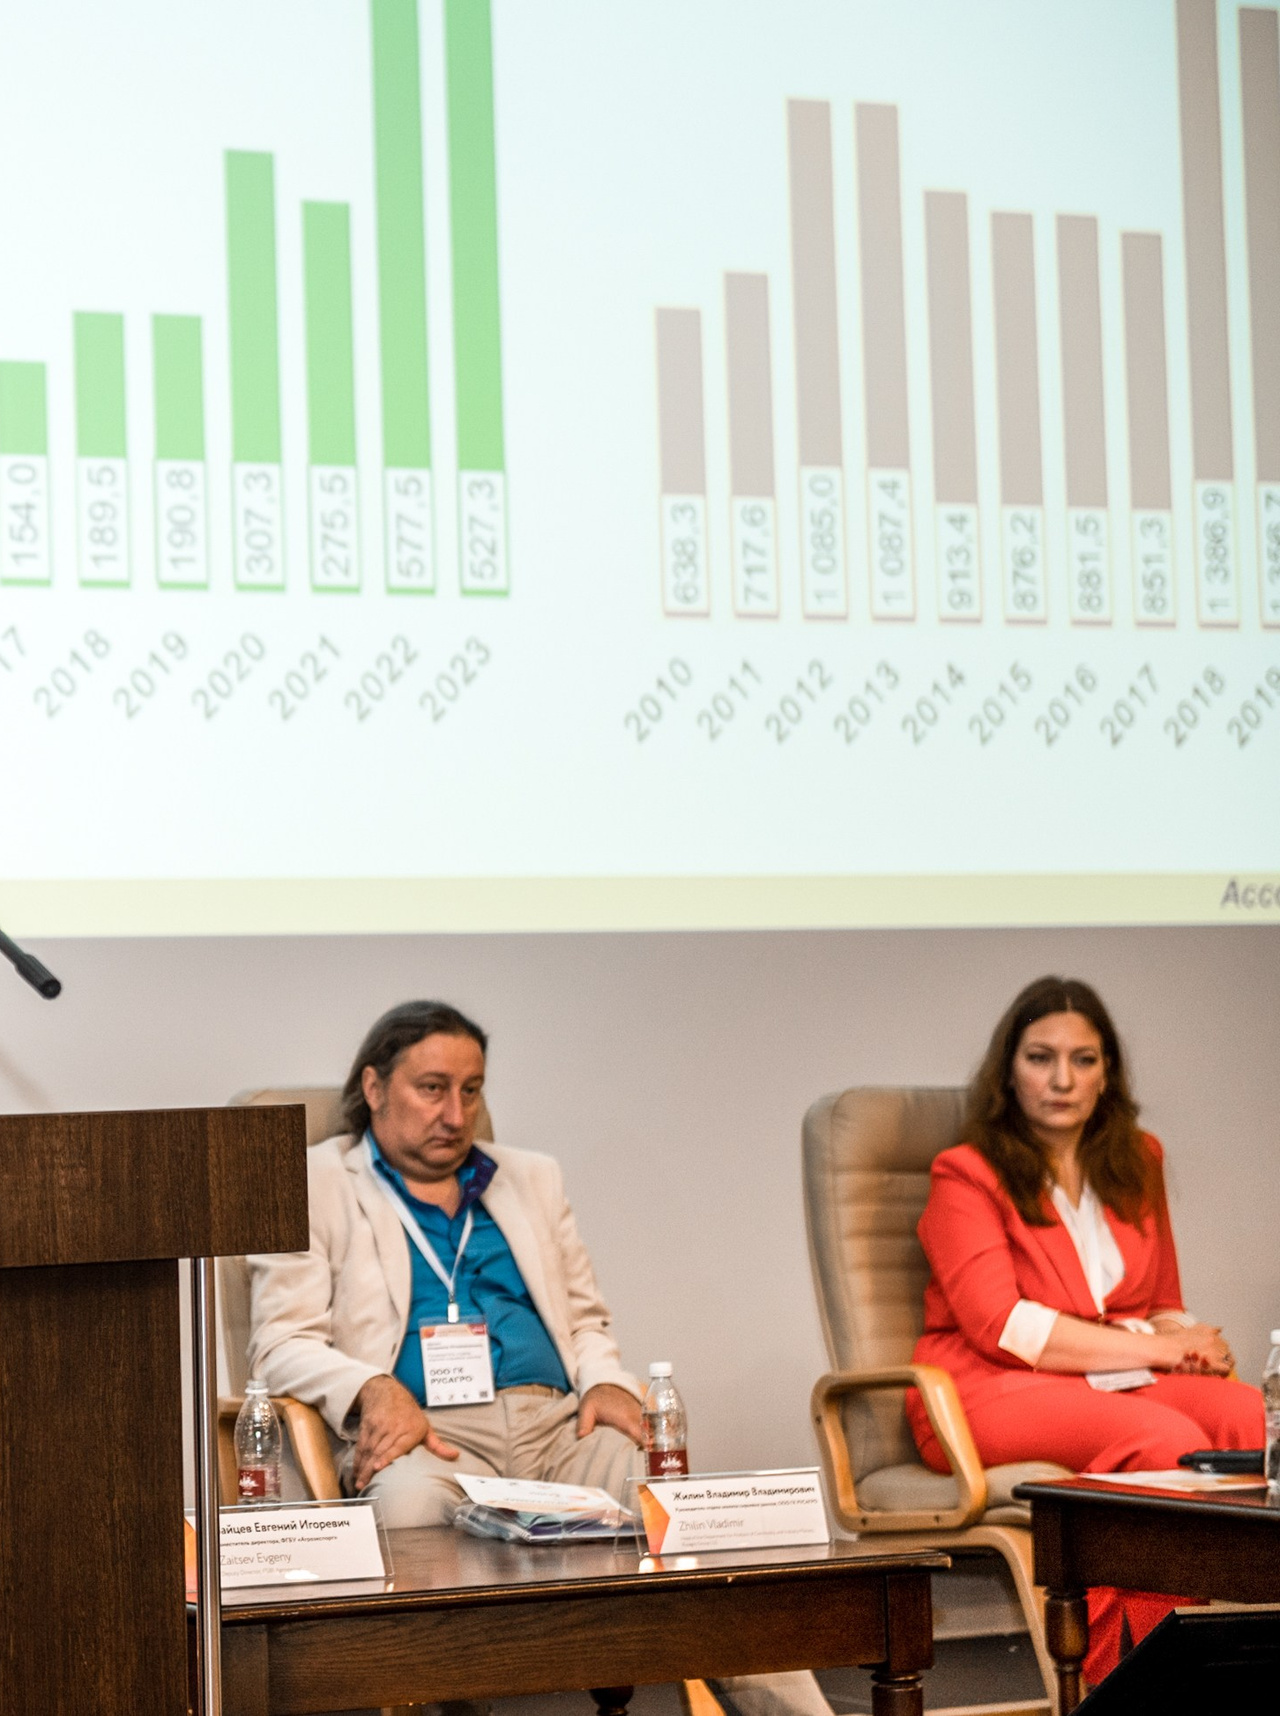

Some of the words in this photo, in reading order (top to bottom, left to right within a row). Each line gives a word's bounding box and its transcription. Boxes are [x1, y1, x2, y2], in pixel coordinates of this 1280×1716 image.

[7, 463, 40, 565] 154,0
[87, 465, 119, 567] 189,5
[166, 468, 197, 569] 190,8
[243, 470, 275, 574] 307,3
[319, 473, 352, 578] 275,5
[393, 475, 426, 580] 577,5
[468, 478, 500, 582] 527,3
[671, 502, 702, 605] 638,3
[741, 504, 772, 606] 717,6
[808, 474, 838, 573] 085,0
[877, 478, 907, 574] 087,4
[946, 513, 973, 610] 913,4
[1010, 513, 1038, 611] 876,2
[1076, 514, 1106, 613] 881,5
[1140, 517, 1169, 615] 851,3
[33, 629, 111, 718] 2018
[113, 631, 189, 720] 2019
[190, 632, 267, 721] 2020
[268, 634, 341, 722] 2021
[344, 634, 419, 723] 2022
[418, 636, 492, 724] 2023
[624, 656, 693, 744] 2010
[696, 658, 762, 743] 2011
[764, 658, 834, 745] 2012
[832, 659, 901, 746] 2013
[900, 661, 966, 747] 2014
[968, 662, 1035, 747] 2015
[1034, 663, 1099, 748] 2016
[1099, 662, 1159, 749] 2017
[1163, 665, 1226, 749] 2018
[429, 1368, 450, 1377] ООО
[430, 1375, 473, 1385] РУСАГРО
[221, 1524, 252, 1535] айцев
[254, 1520, 297, 1533] Евгений
[299, 1518, 350, 1532] Игоревич
[673, 1491, 705, 1501] Жилин
[706, 1488, 750, 1499] Владимир
[751, 1486, 815, 1497] Владимирович
[678, 1521, 706, 1532] Zhilin
[707, 1518, 744, 1530] Vladimir
[220, 1554, 254, 1566] Zaitsev
[256, 1552, 292, 1565] Evgeny
